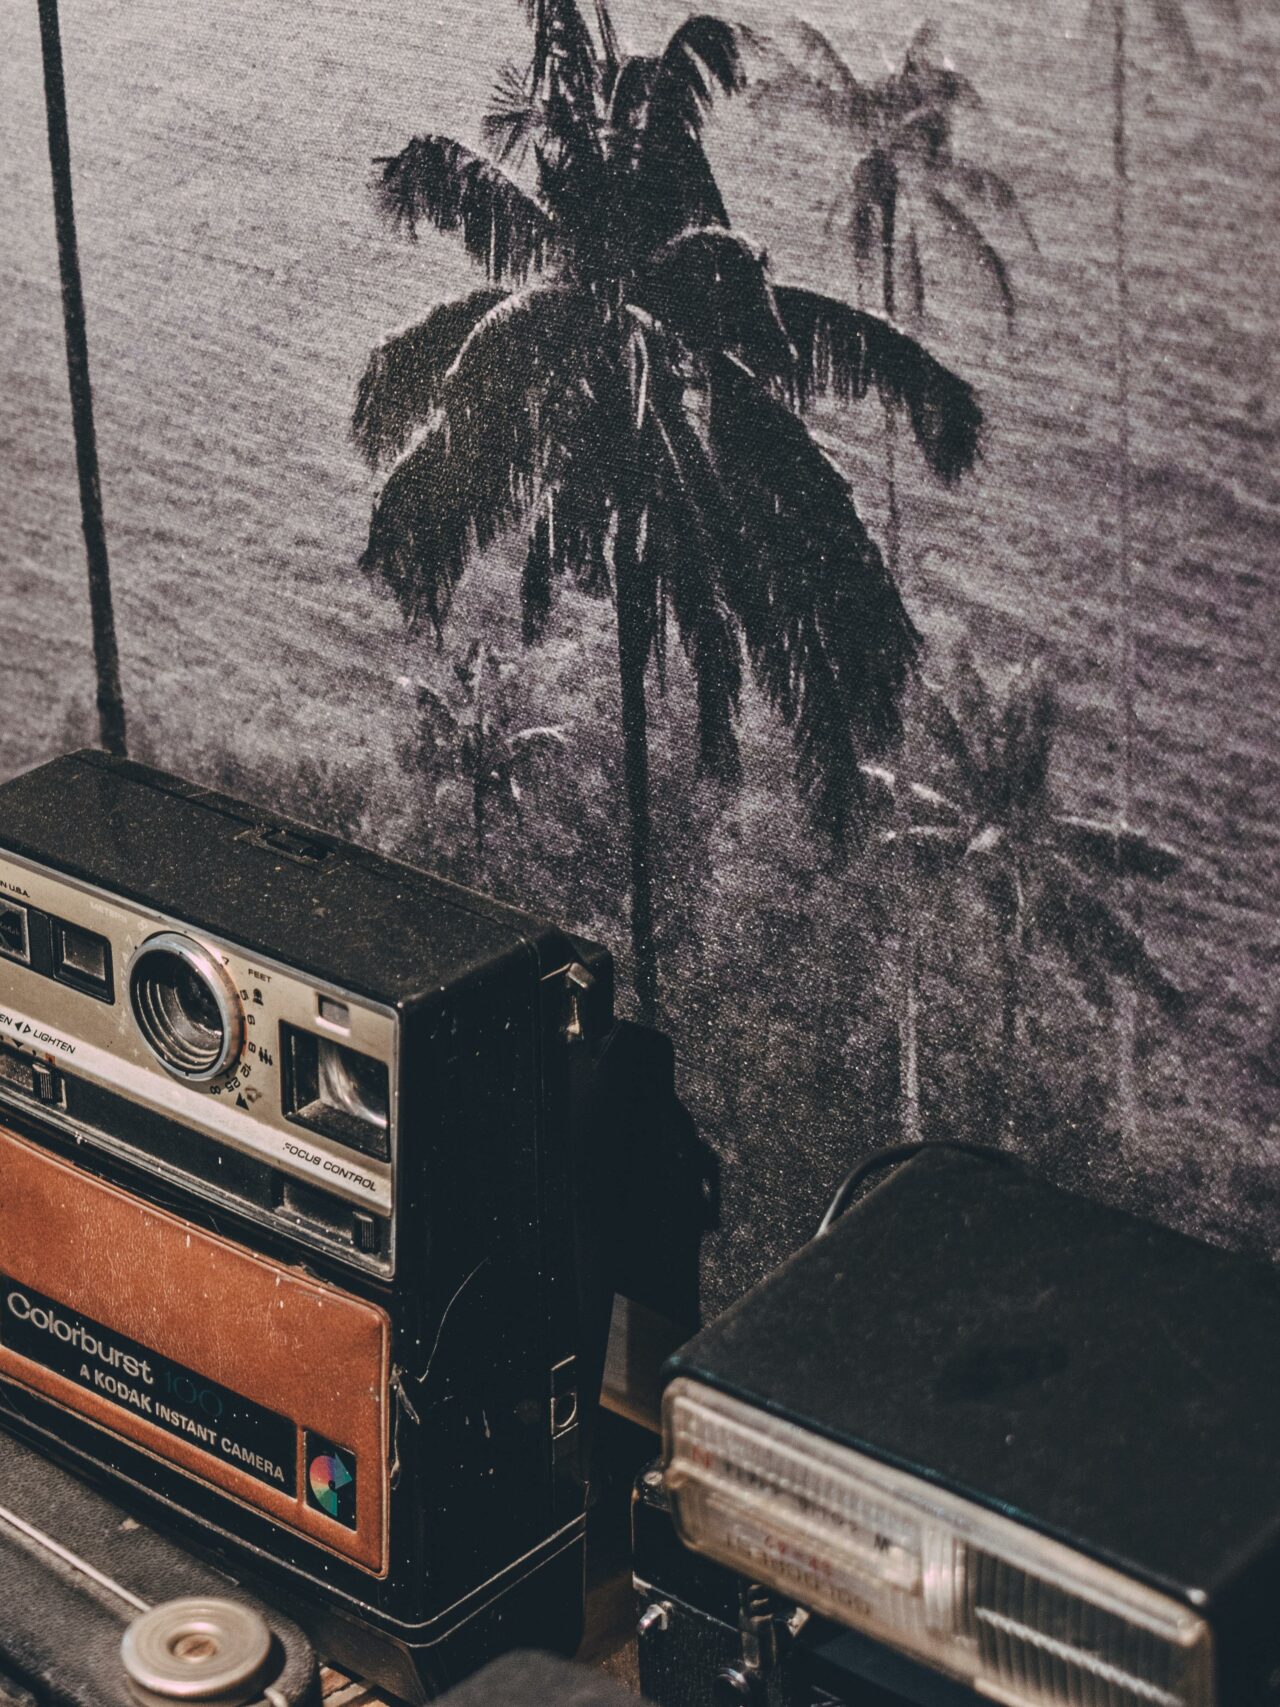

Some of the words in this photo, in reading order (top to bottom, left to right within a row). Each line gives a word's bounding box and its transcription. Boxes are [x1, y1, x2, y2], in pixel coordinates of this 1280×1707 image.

[0, 879, 7, 889] IN
[248, 968, 272, 983] FEET
[240, 989, 249, 1001] 5
[247, 1014, 255, 1027] 6
[33, 1030, 76, 1054] LIGHTEN
[248, 1041, 256, 1054] 8
[240, 1063, 252, 1078] 12
[225, 1077, 241, 1093] 25
[282, 1142, 322, 1166] FOCUS
[323, 1161, 377, 1192] CONTROL
[7, 1292, 155, 1385] Colorburst
[163, 1367, 224, 1417] 100
[79, 1364, 91, 1380] A
[94, 1368, 152, 1413] KODAK
[155, 1402, 218, 1446] INSTANT
[221, 1437, 285, 1482] CAMERA
